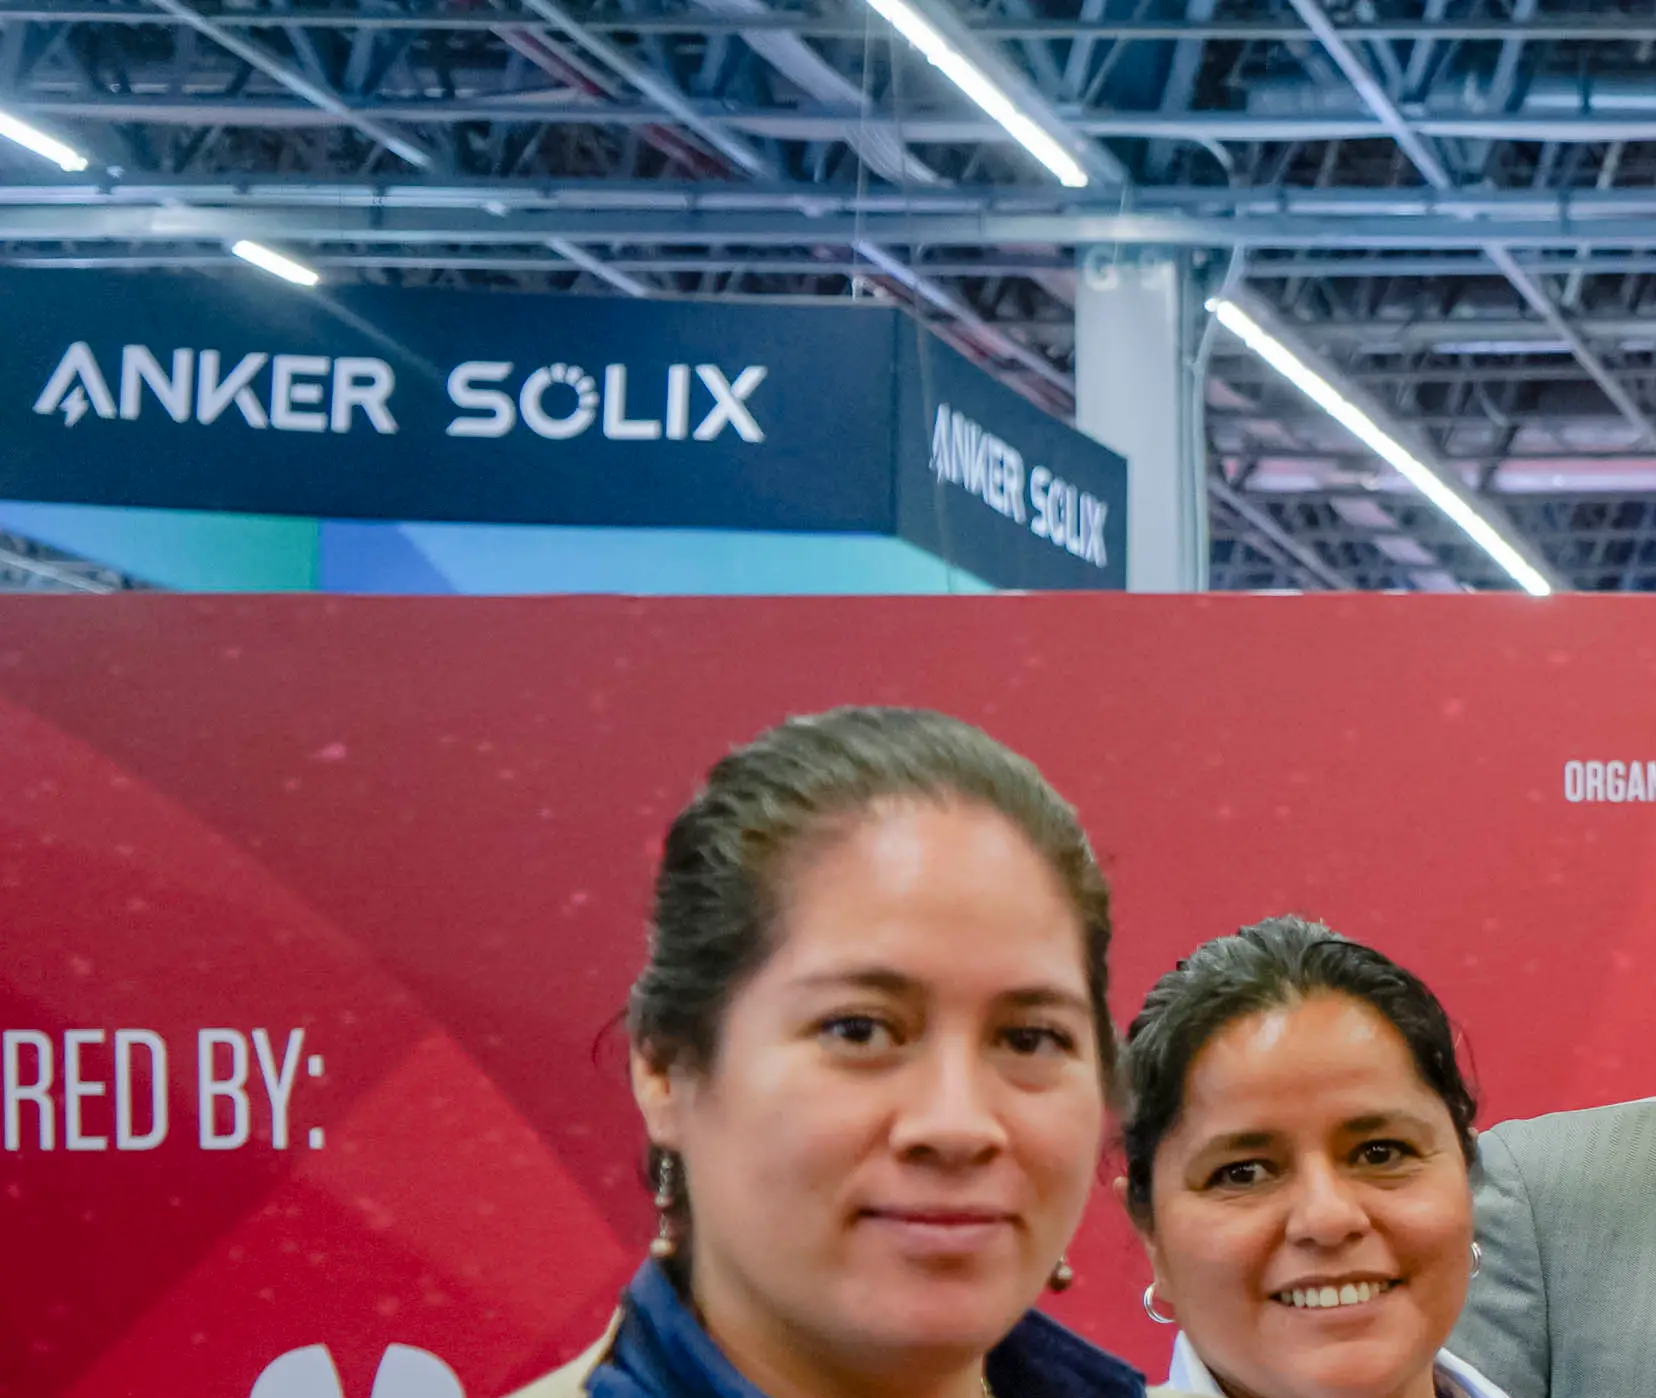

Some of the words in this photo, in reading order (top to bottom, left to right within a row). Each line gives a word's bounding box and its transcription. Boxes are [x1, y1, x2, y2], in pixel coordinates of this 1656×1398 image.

[33, 341, 398, 434] ANKER
[446, 360, 768, 444] SOLIX
[929, 402, 1027, 524] ANKER
[1030, 464, 1108, 568] SOLIX
[199, 1028, 325, 1150] BY:
